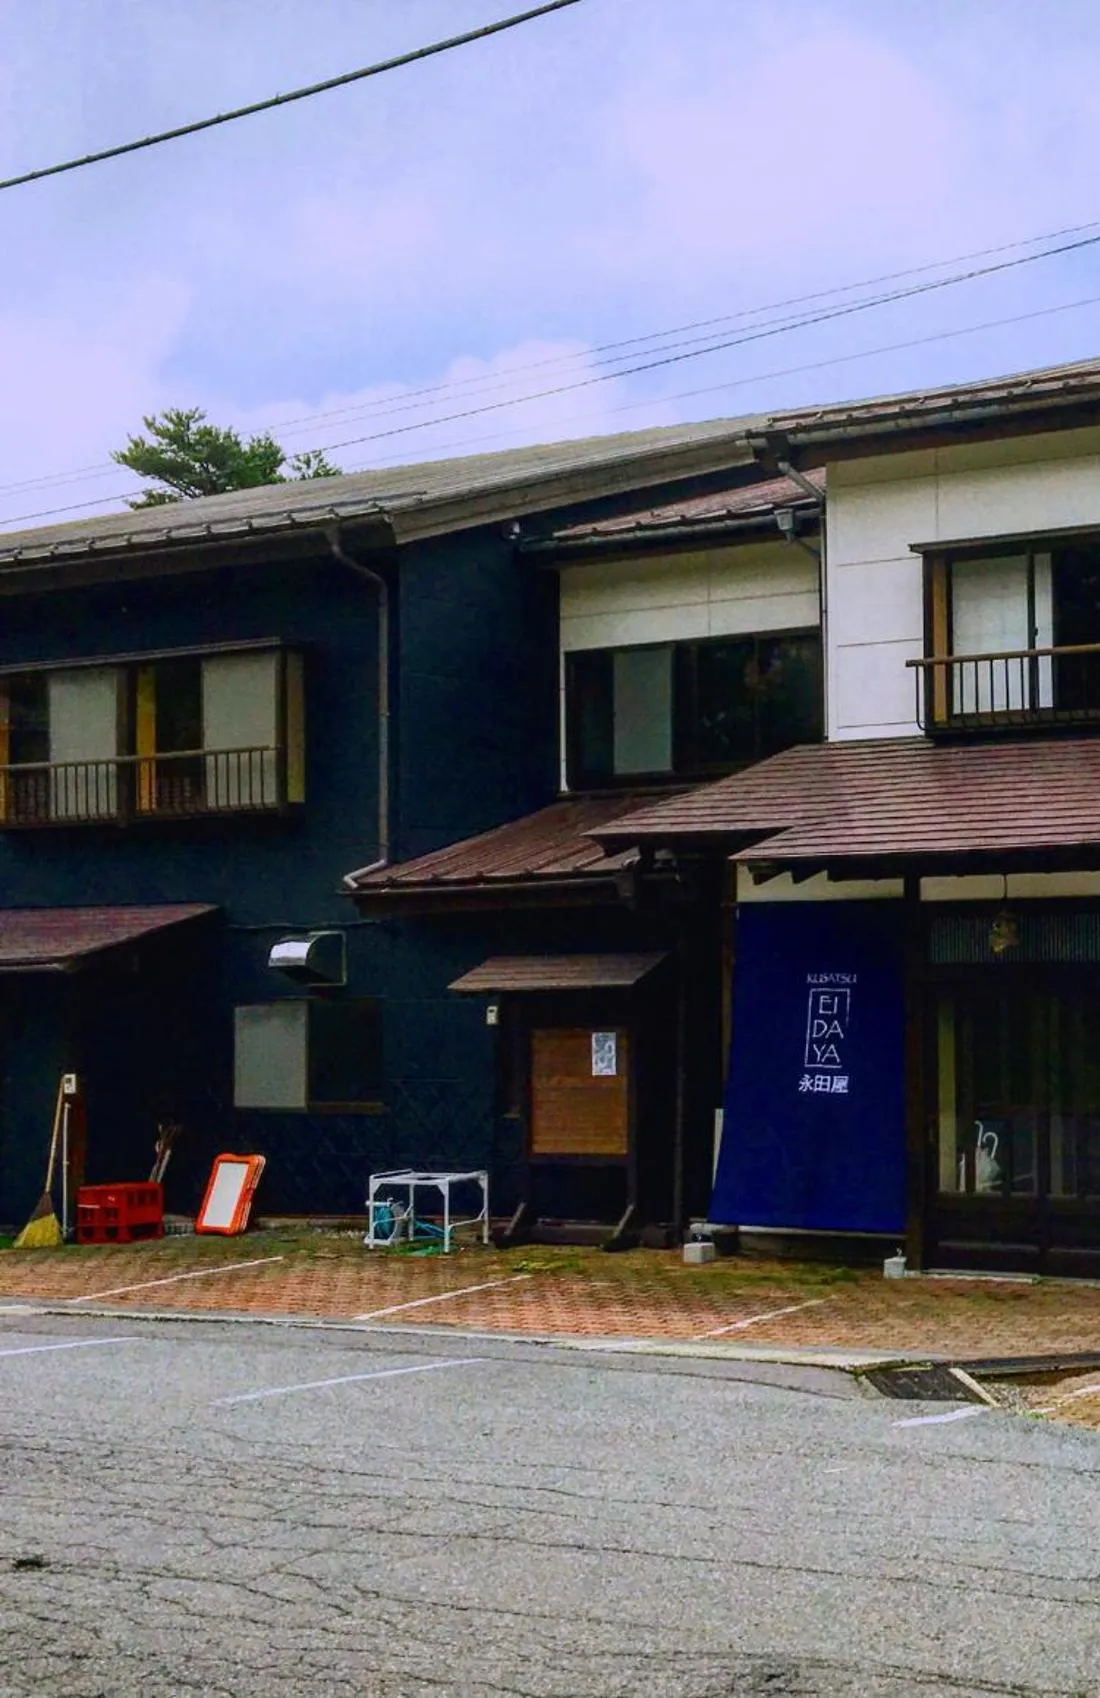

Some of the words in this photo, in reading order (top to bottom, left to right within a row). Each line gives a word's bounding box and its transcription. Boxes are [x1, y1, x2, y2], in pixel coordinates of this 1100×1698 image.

[812, 1019, 844, 1039] DA
[813, 1044, 840, 1063] YA
[798, 1074, 849, 1093] 永田屋
